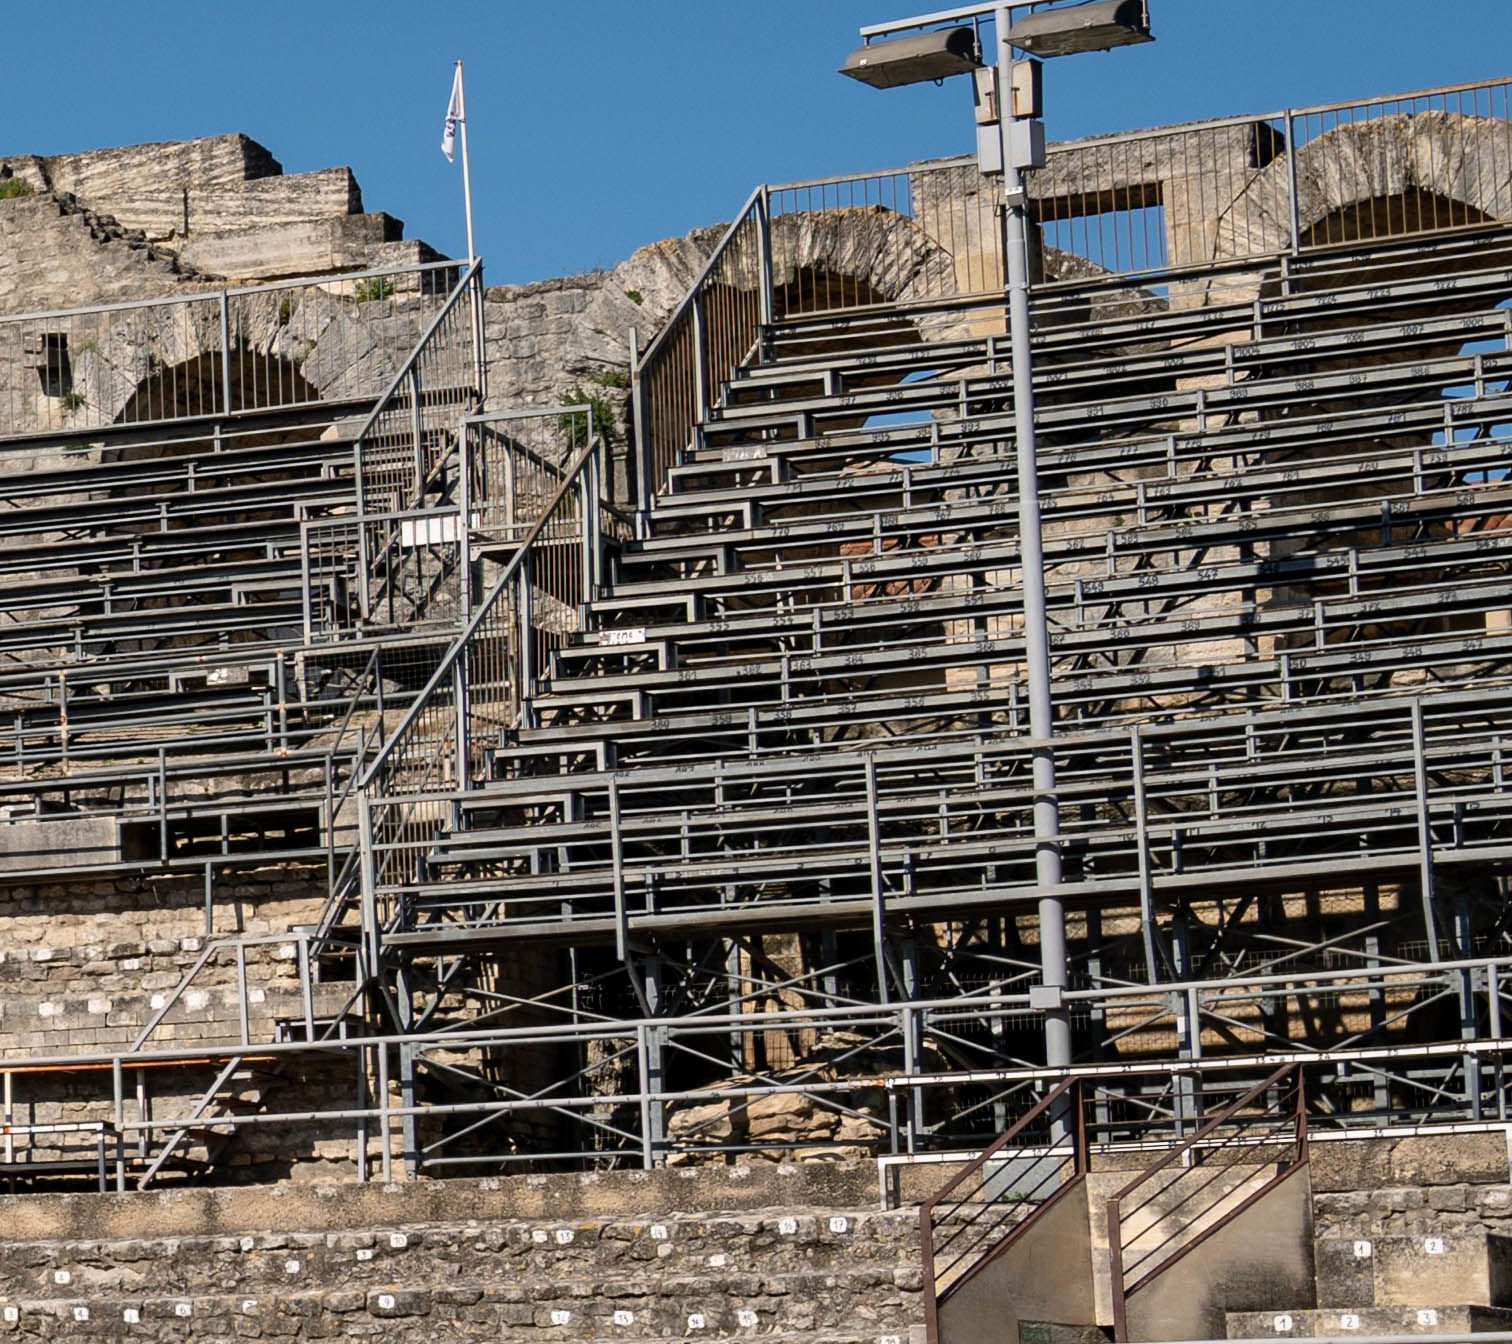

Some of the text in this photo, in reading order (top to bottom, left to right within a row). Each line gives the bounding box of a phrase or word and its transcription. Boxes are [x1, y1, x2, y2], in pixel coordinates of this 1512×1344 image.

[834, 1220, 843, 1230] 17
[1359, 1244, 1363, 1254] 1
[1430, 1242, 1436, 1251] 2
[1280, 1319, 1285, 1328] 1
[1347, 1317, 1352, 1327] 2
[1424, 1313, 1431, 1325] 3
